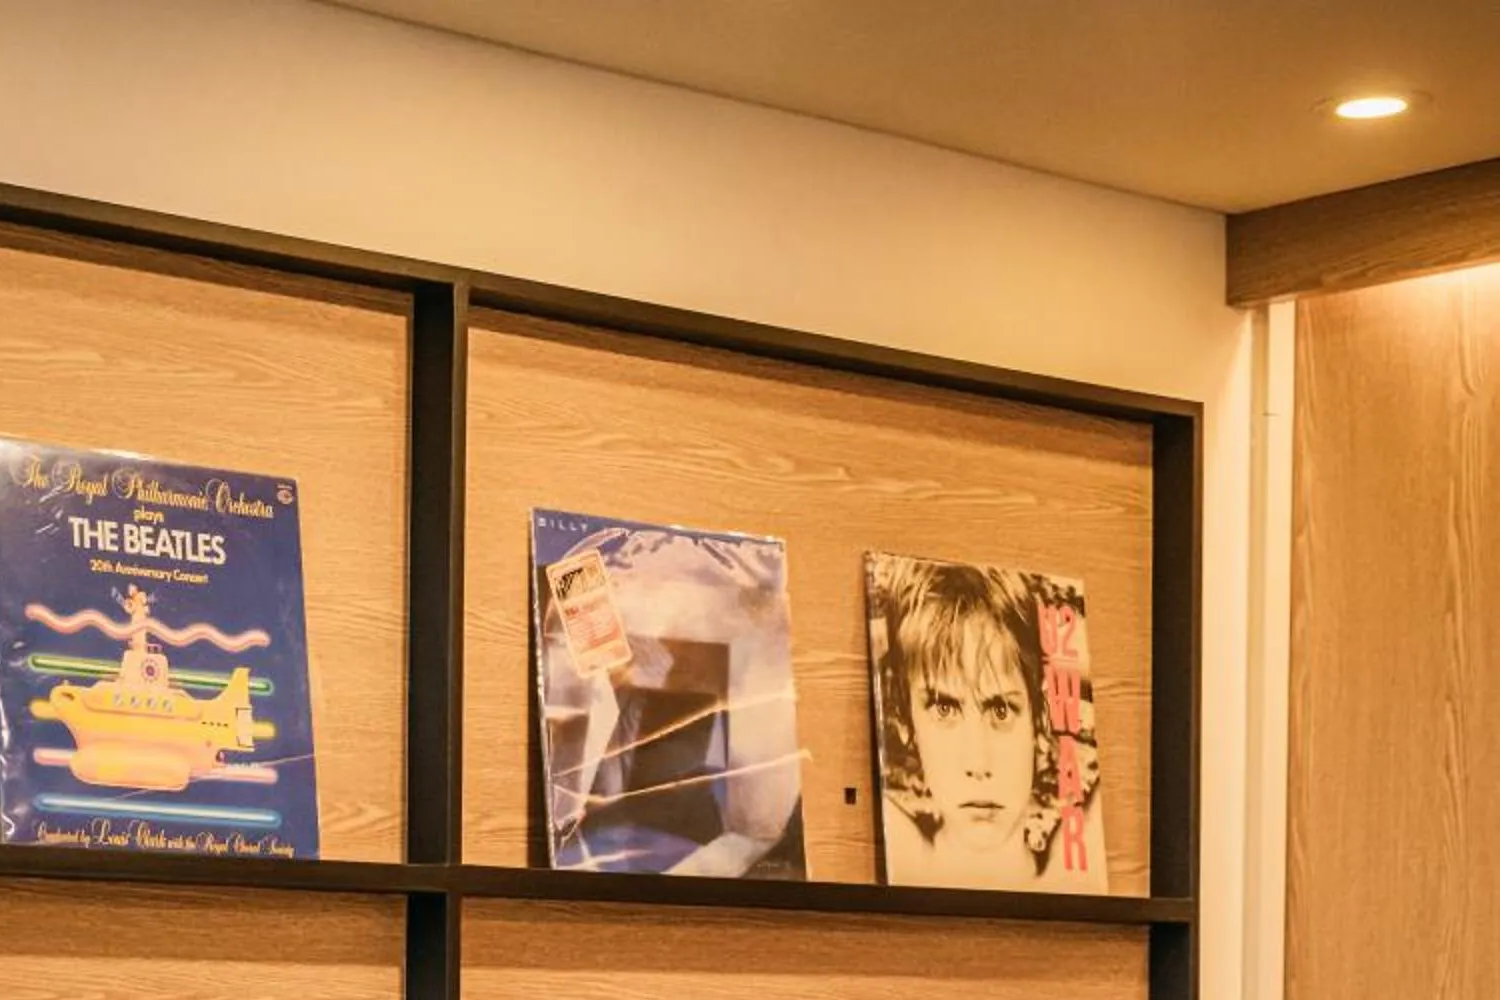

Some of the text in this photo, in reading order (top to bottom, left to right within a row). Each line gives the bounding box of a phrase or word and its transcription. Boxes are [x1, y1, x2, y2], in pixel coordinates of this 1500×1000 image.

[133, 507, 164, 525] plays
[538, 517, 588, 532] BILLY
[68, 517, 226, 565] THE BEATLES
[1038, 603, 1079, 657] U2
